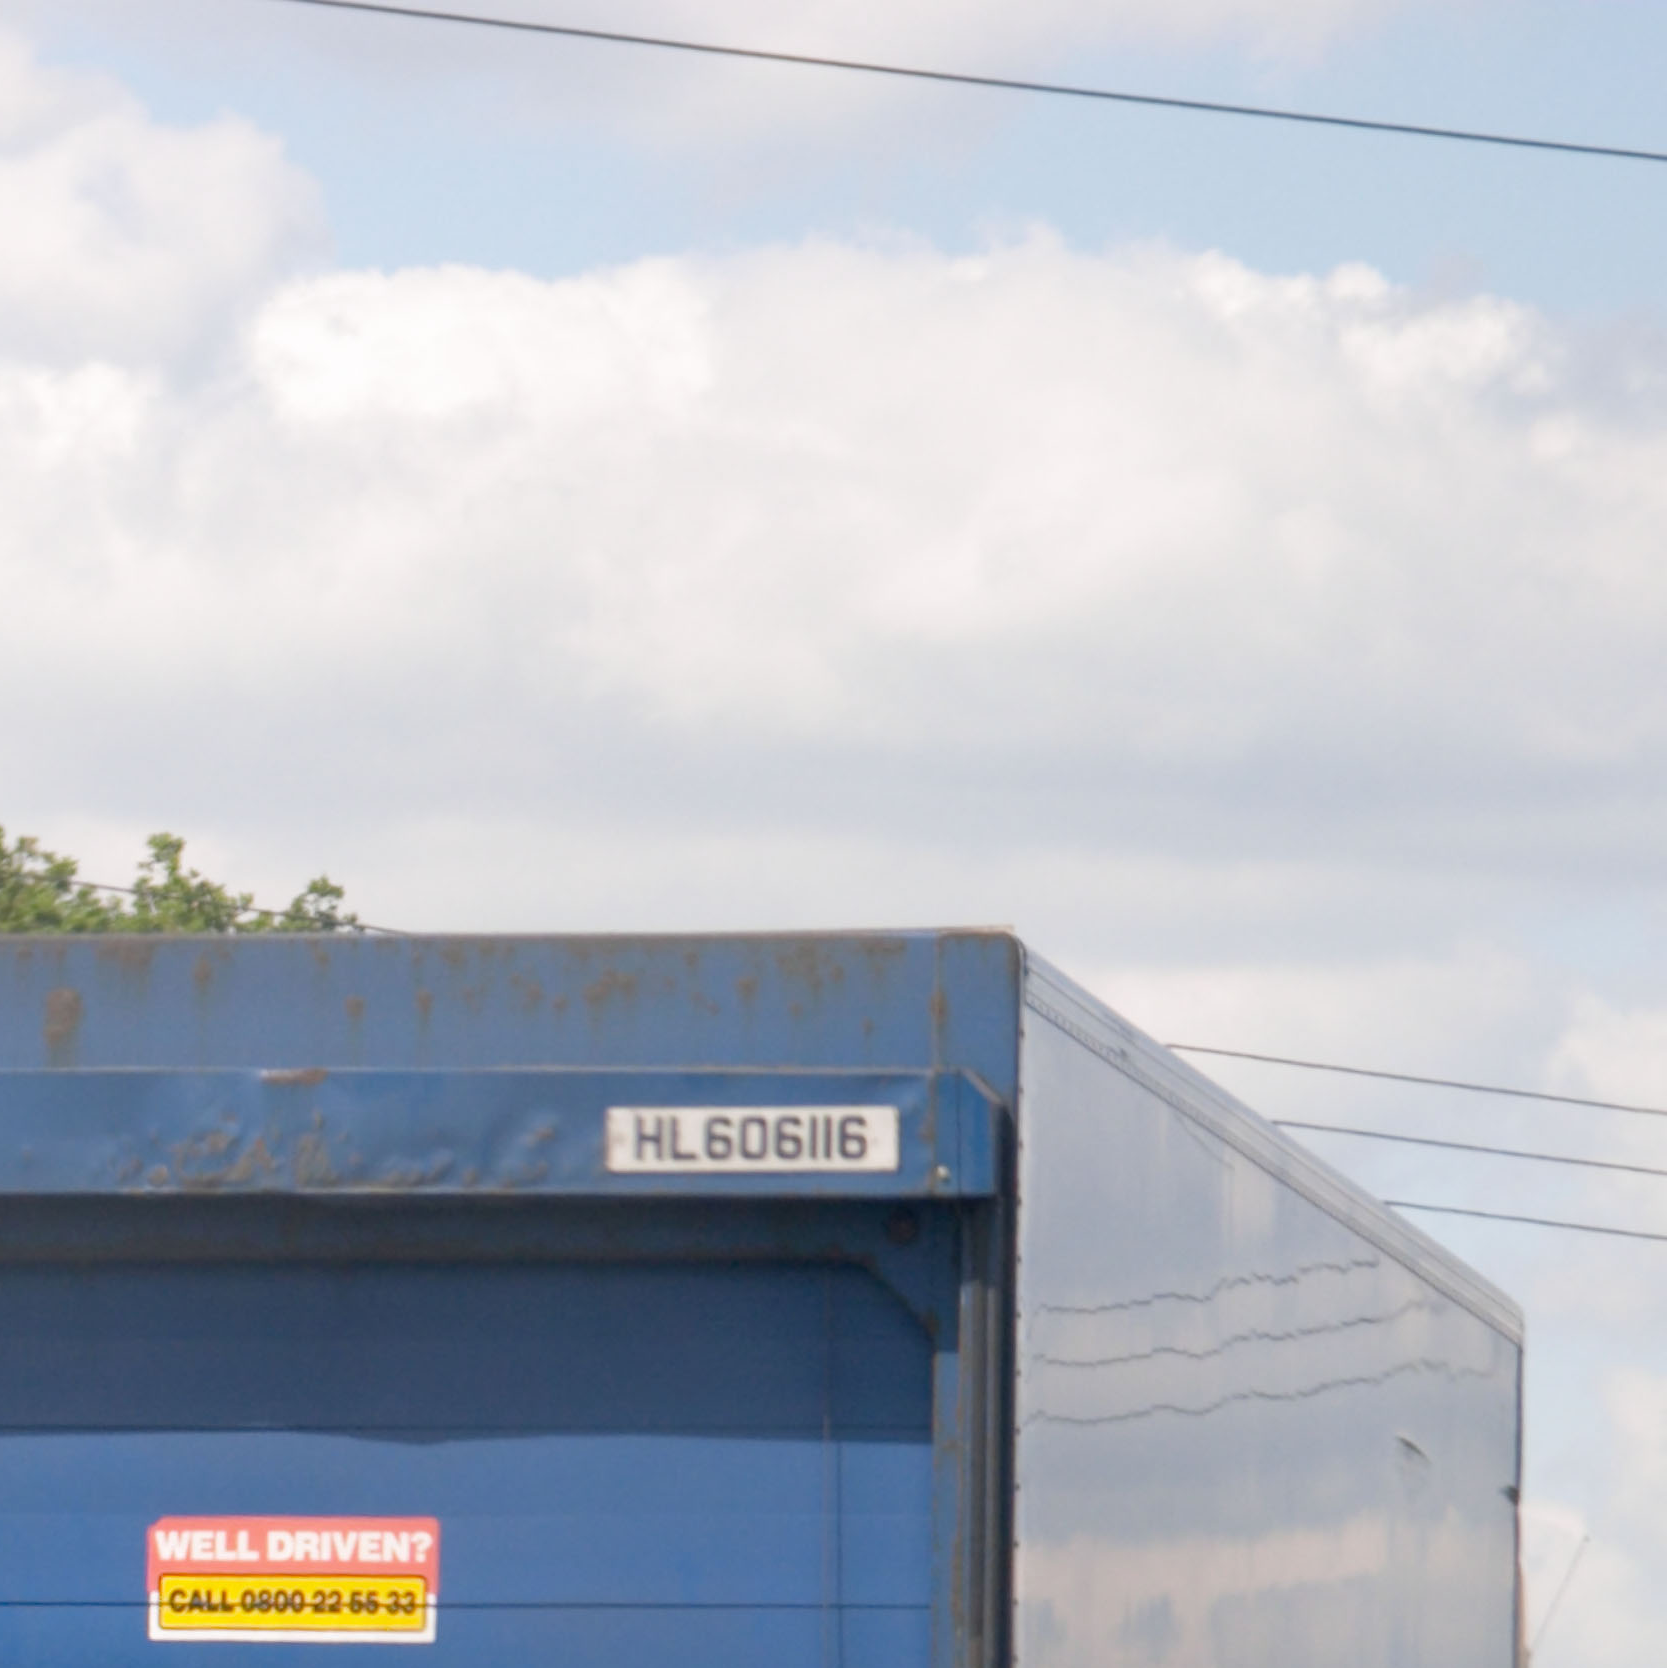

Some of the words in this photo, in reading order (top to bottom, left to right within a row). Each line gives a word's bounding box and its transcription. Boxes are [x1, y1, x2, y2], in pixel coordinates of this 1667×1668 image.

[634, 1115, 868, 1160] HL606116
[155, 1530, 260, 1561] WELL
[267, 1530, 433, 1563] DRIVEN?
[169, 1589, 233, 1613] CALL
[241, 1589, 304, 1614] 0800
[314, 1591, 342, 1614] 22
[385, 1592, 416, 1615] 33
